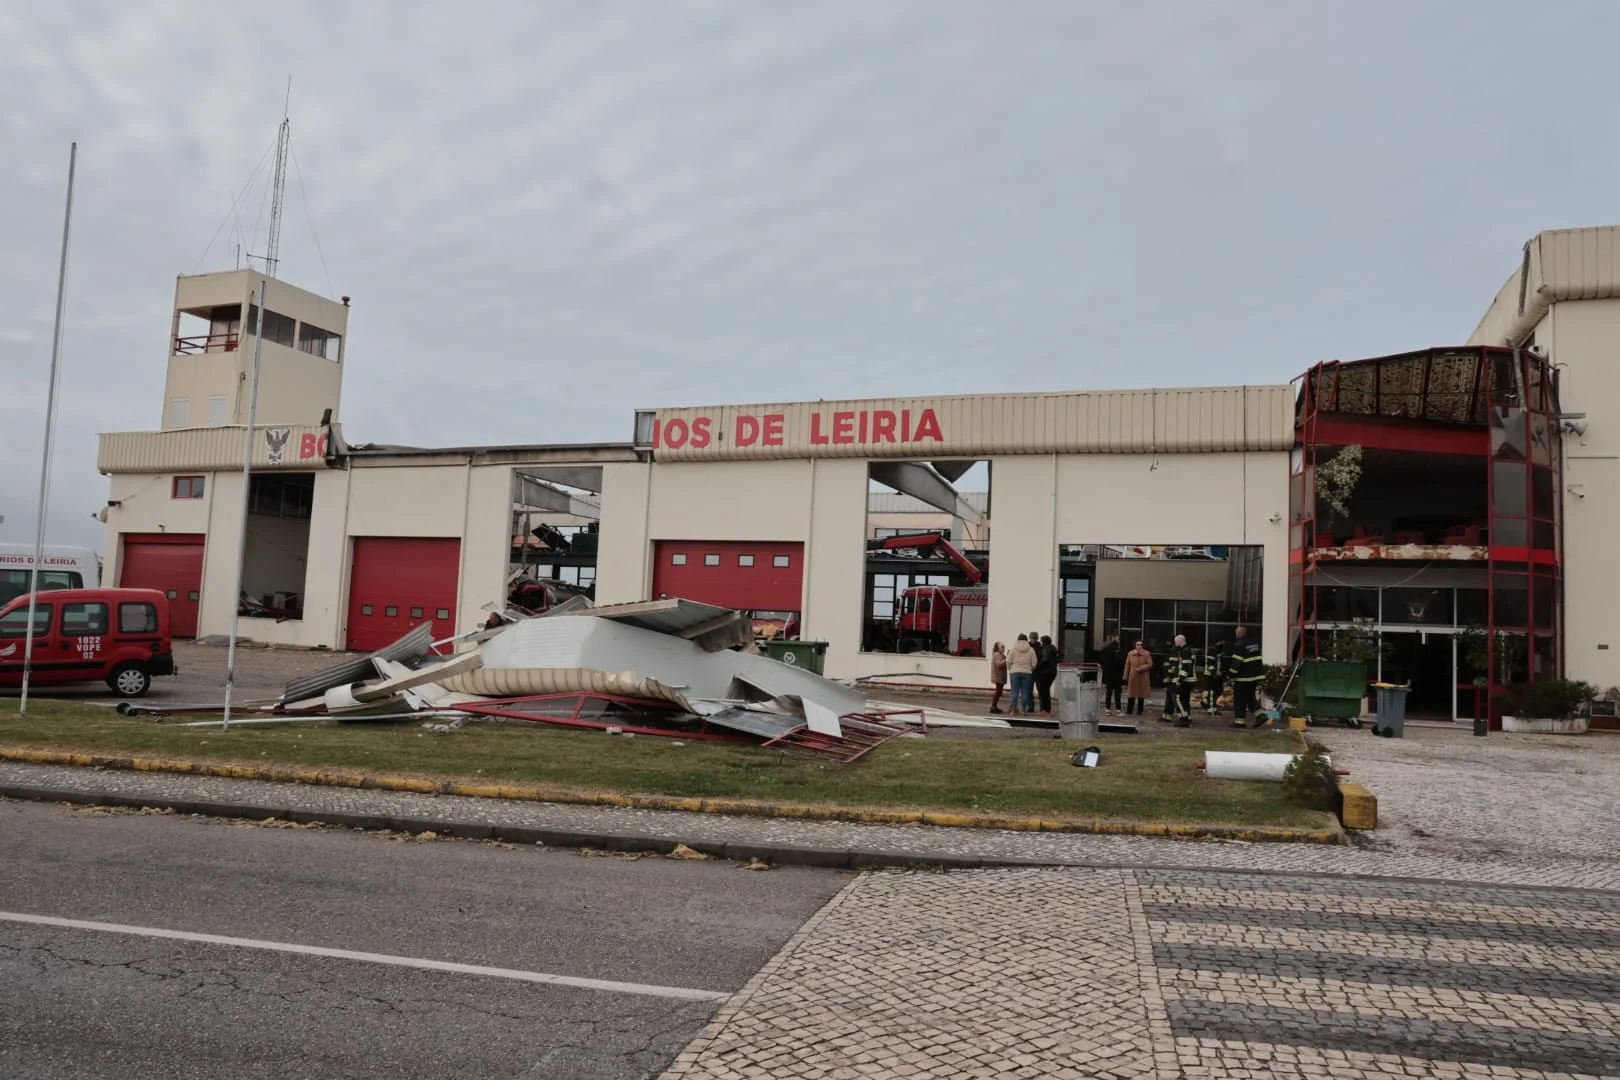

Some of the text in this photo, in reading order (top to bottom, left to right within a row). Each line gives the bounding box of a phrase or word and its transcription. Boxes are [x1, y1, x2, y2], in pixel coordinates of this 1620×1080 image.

[735, 413, 785, 447] DE
[810, 408, 944, 445] LEIRIA
[44, 557, 77, 565] LEIRIA
[77, 636, 101, 644] 1022
[76, 643, 102, 651] VOPE
